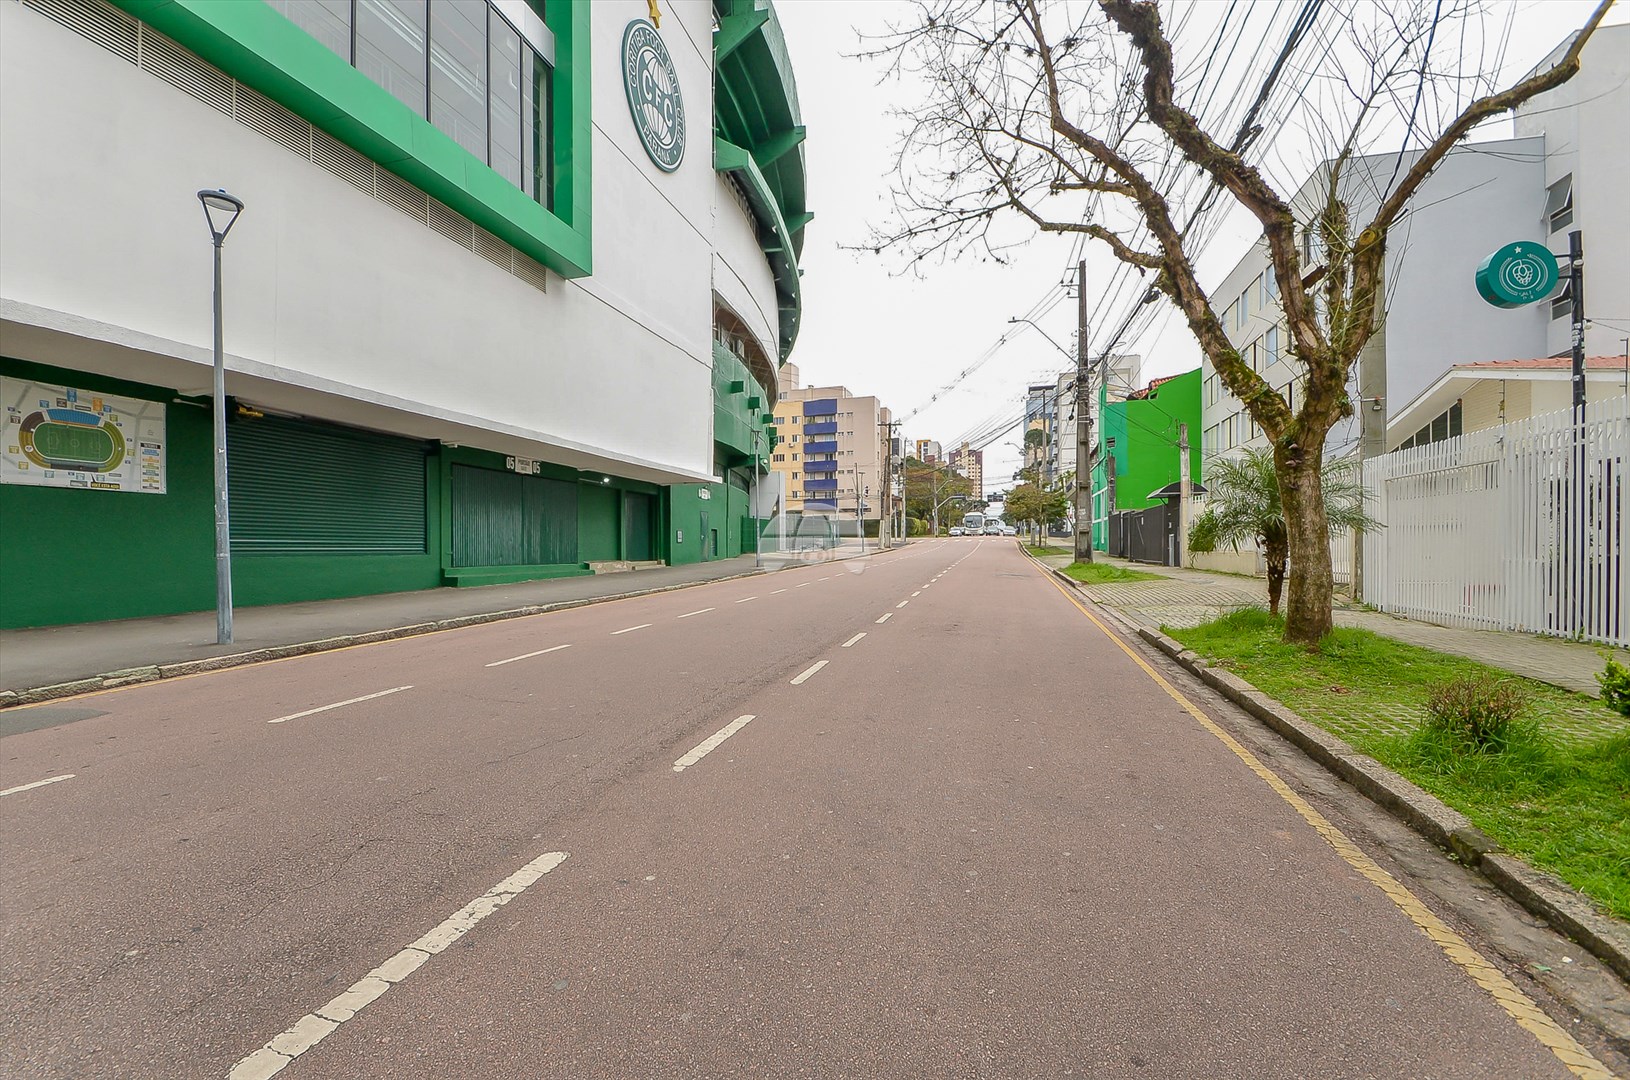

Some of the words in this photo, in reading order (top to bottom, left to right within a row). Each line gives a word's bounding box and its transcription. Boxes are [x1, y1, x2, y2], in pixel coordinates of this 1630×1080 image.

[629, 29, 646, 87] CORITIBA
[646, 30, 664, 60] FOOT
[677, 108, 685, 147] CLUB
[506, 456, 514, 470] 05
[532, 462, 540, 474] 05
